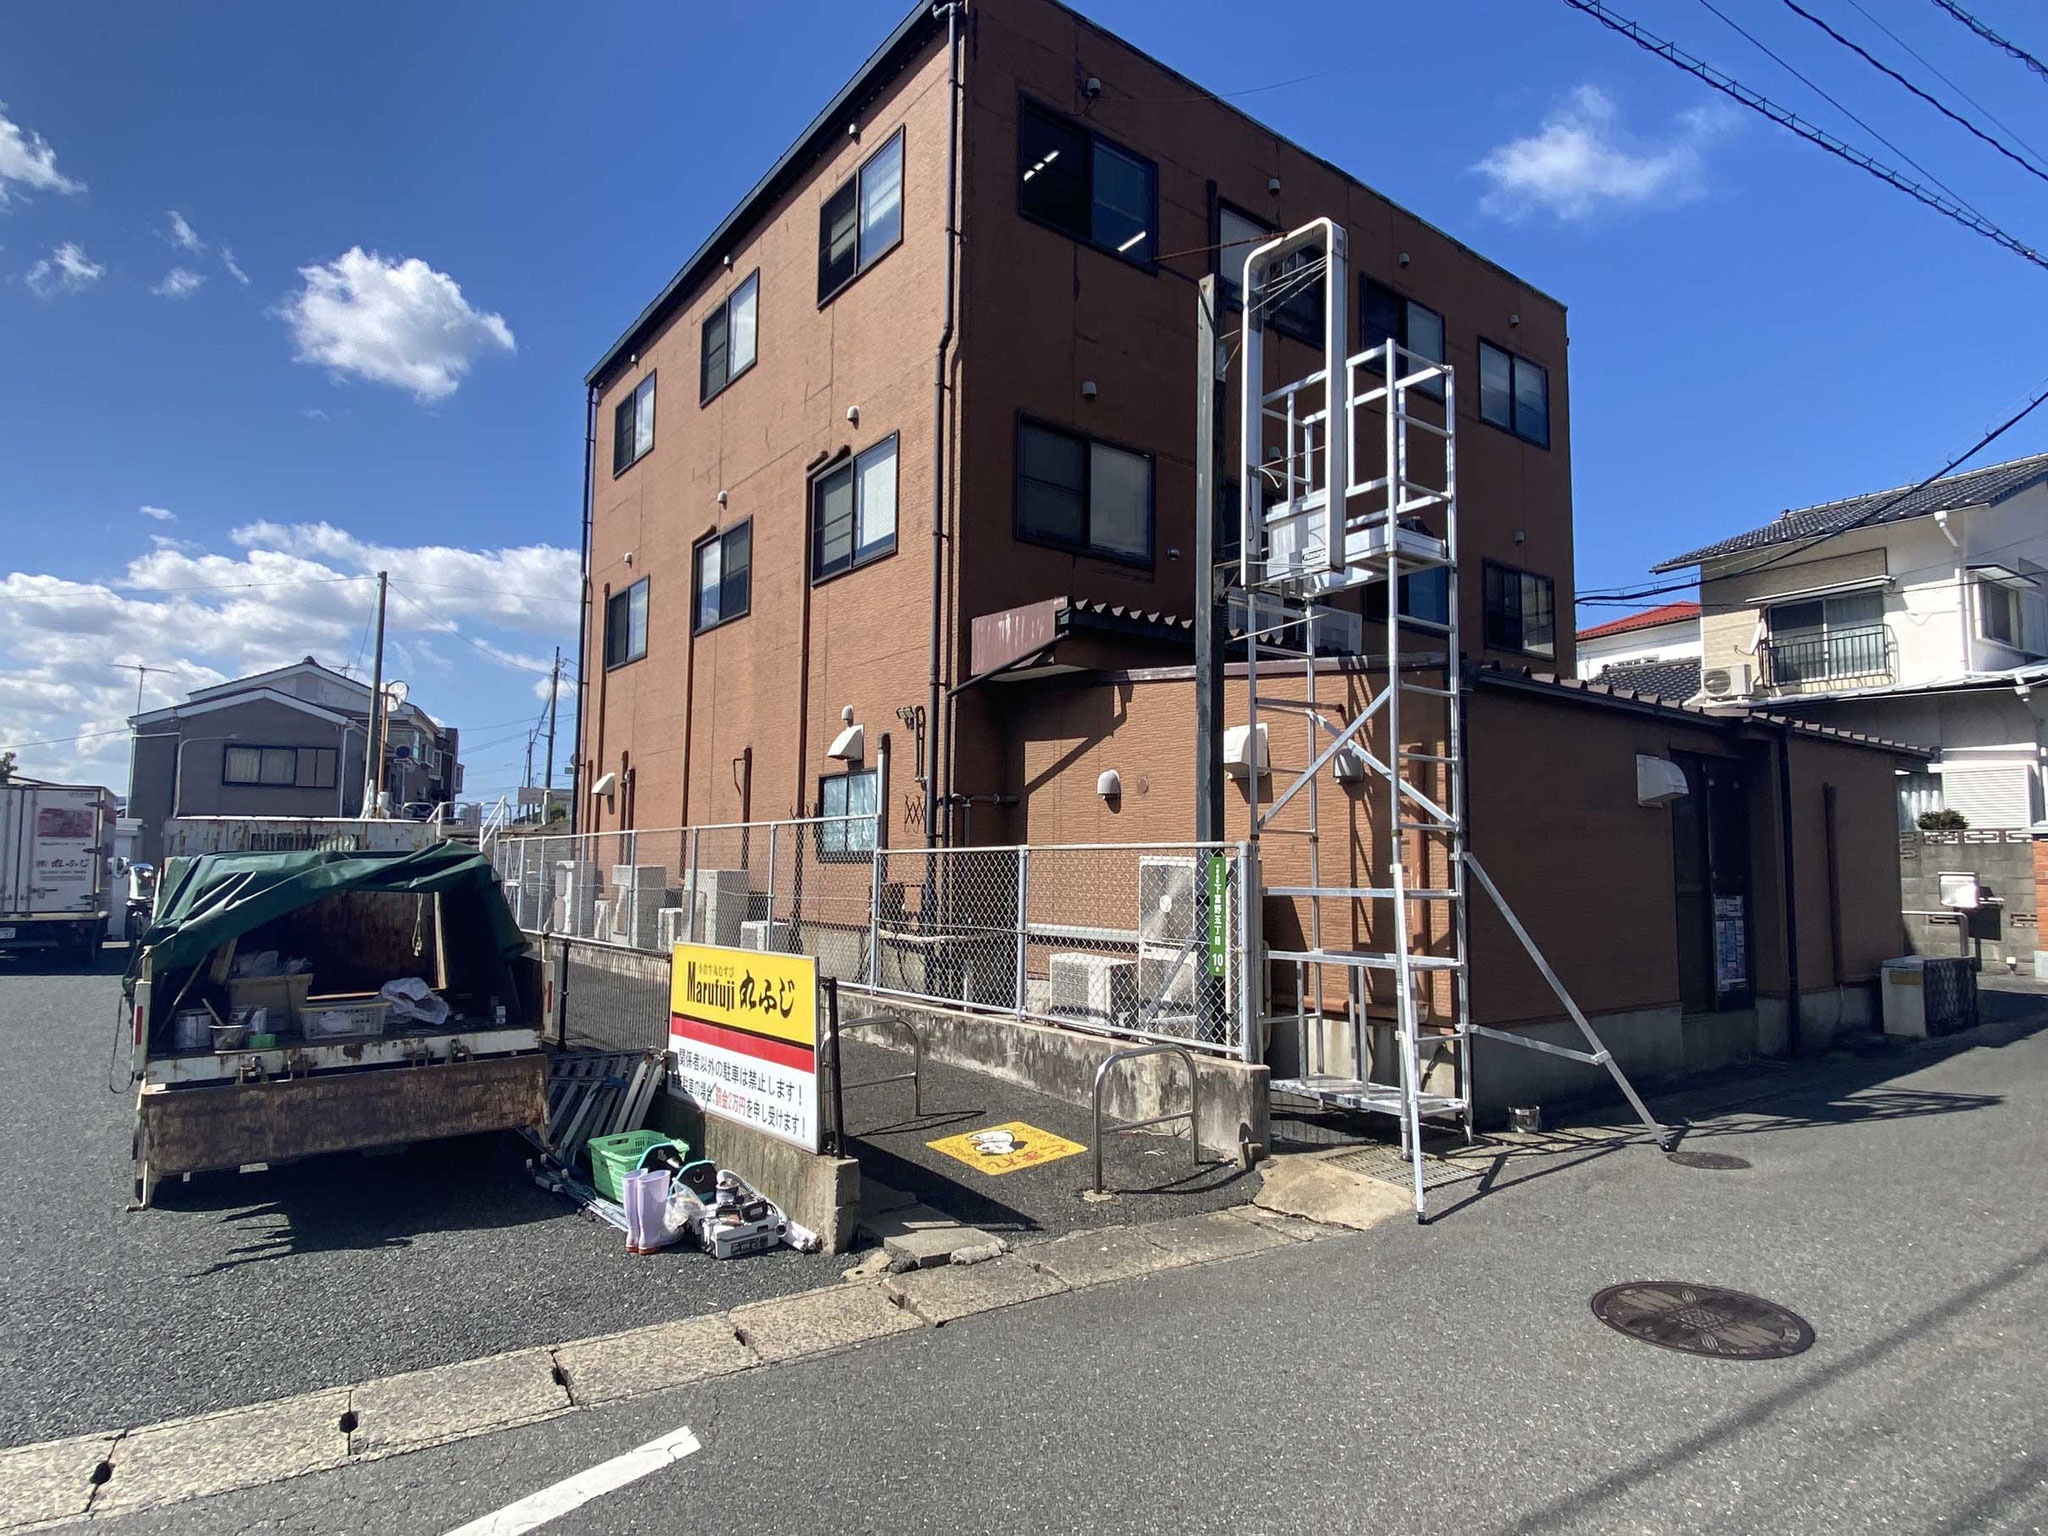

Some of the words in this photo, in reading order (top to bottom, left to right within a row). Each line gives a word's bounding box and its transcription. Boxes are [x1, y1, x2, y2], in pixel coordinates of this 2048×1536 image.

[687, 961, 735, 1012] Marufuji
[739, 968, 796, 1019] 丸ふじ
